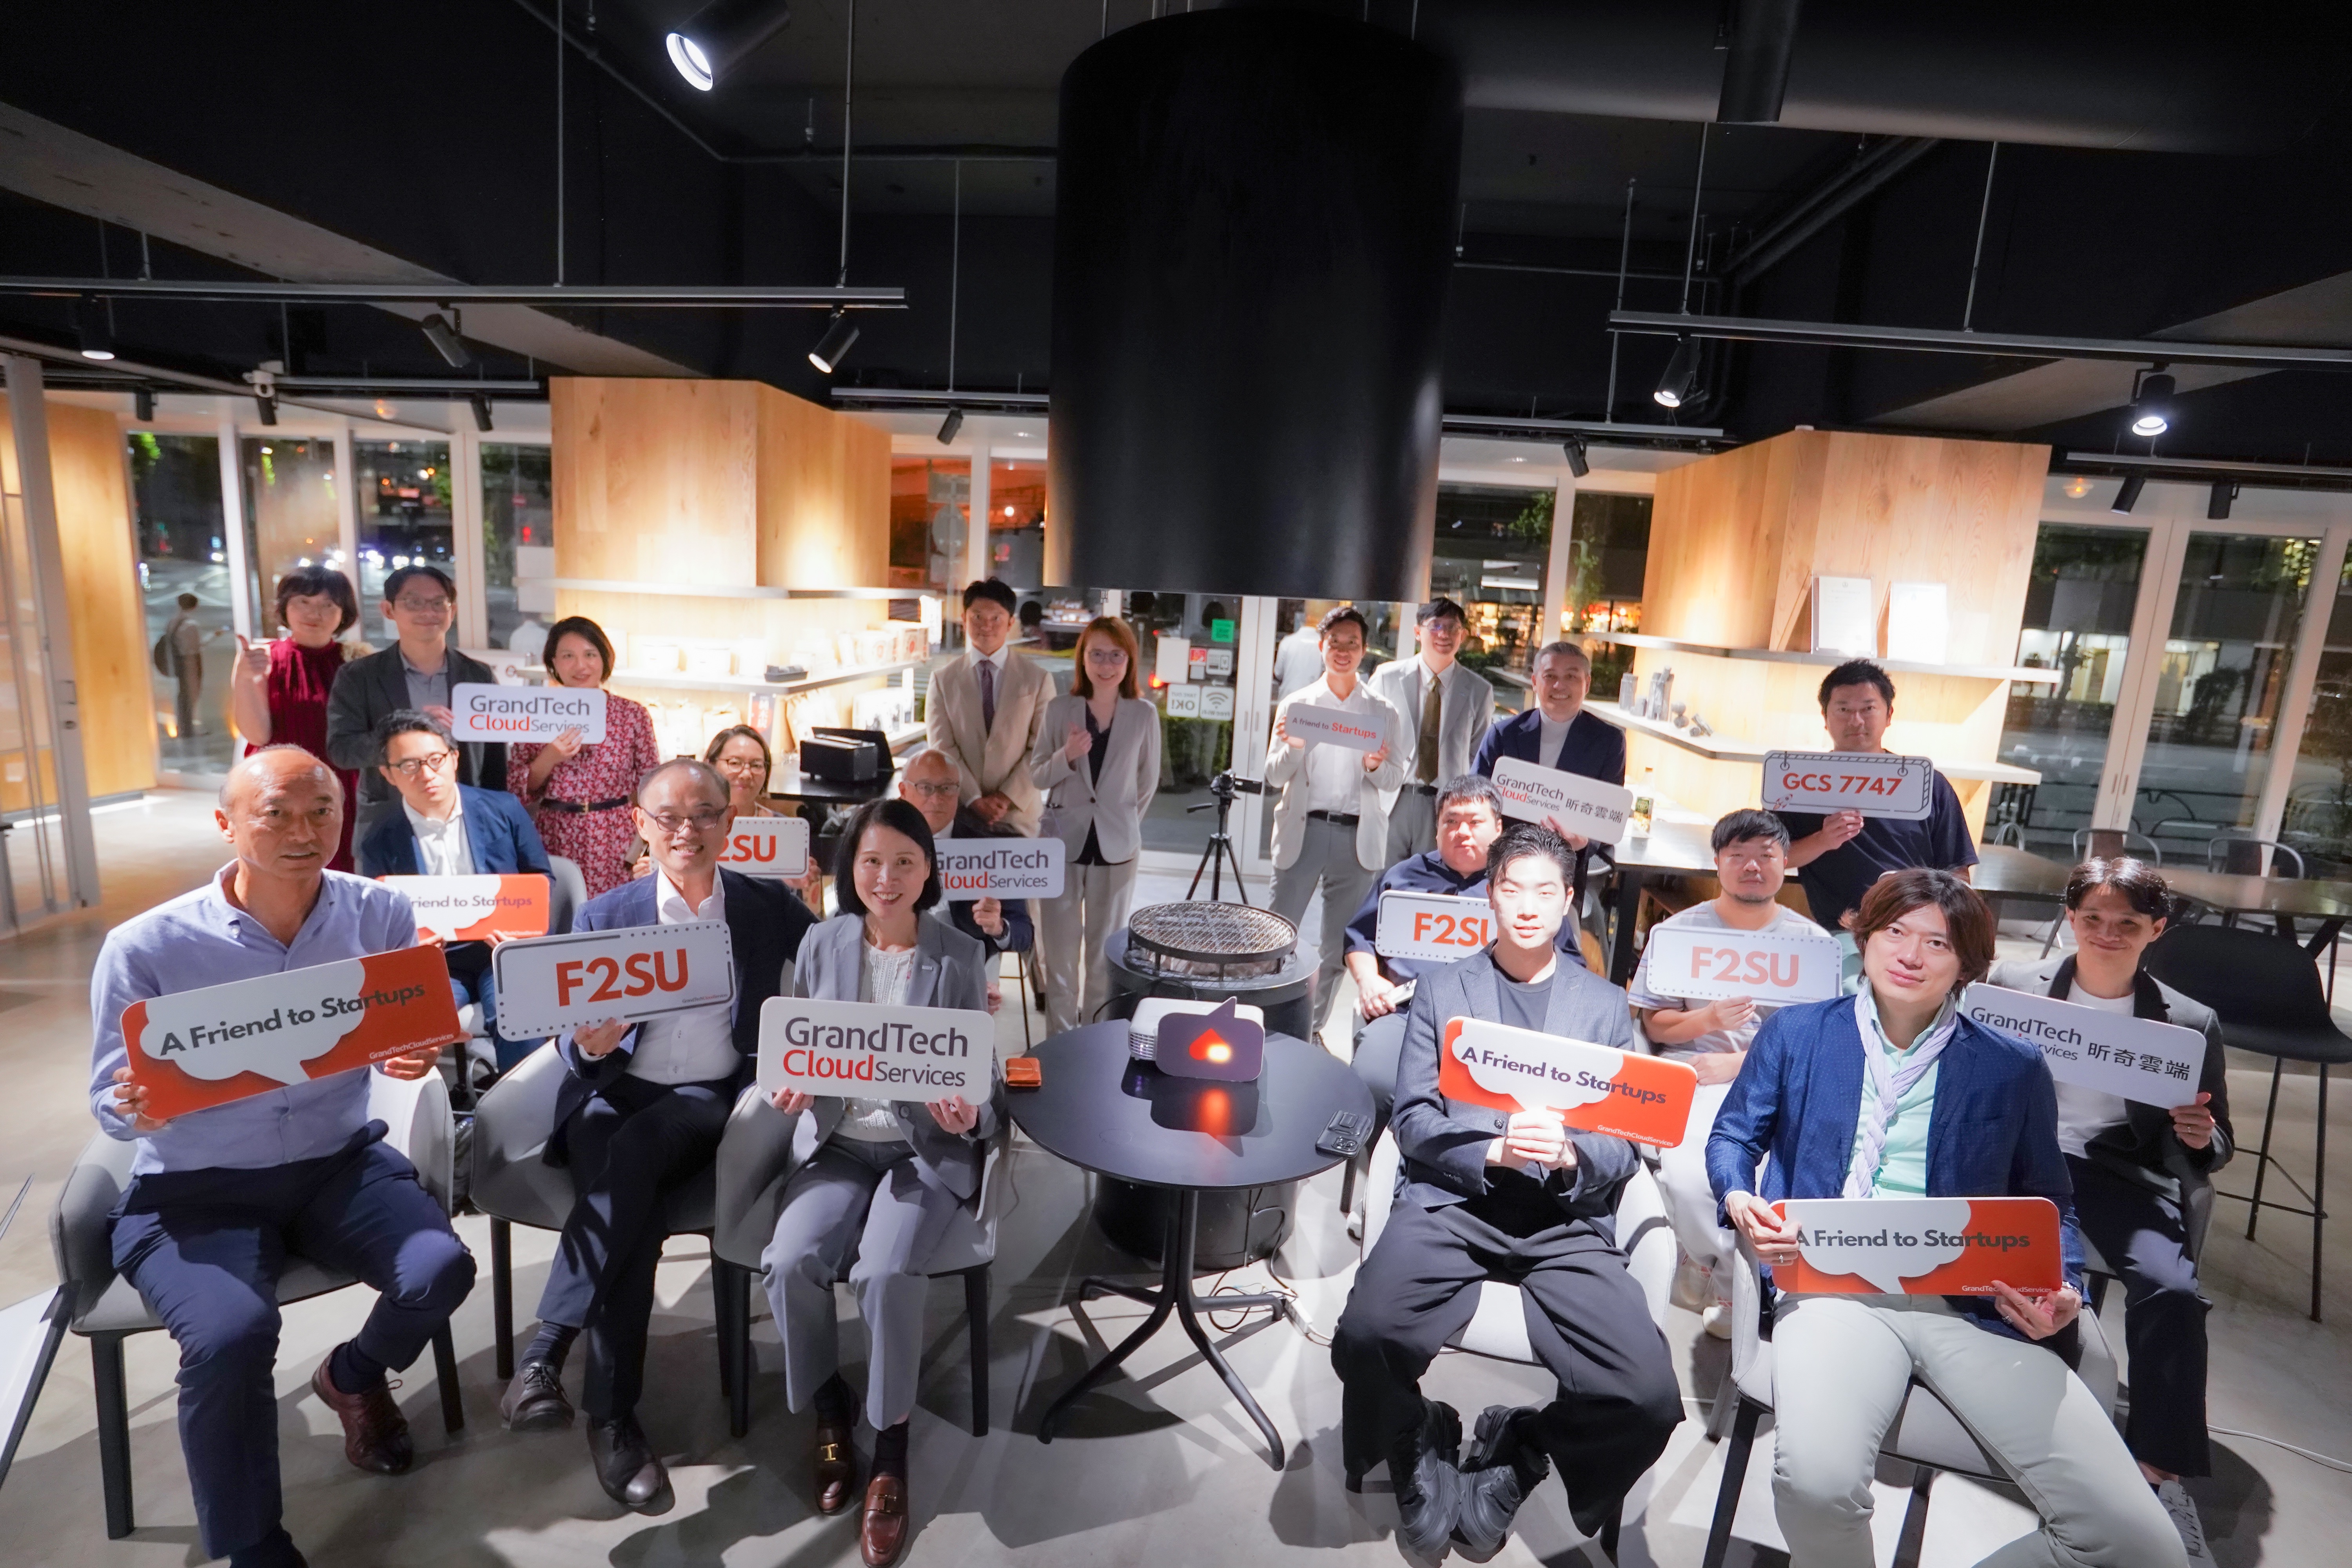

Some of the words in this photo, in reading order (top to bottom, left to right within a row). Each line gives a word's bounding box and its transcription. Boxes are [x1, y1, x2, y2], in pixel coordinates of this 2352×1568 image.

[470, 695, 590, 715] GrandTech
[1299, 718, 1320, 728] friend
[1332, 722, 1377, 739] Startups
[1497, 774, 1564, 801] GrandTech
[1782, 773, 1832, 792] GCS
[1839, 775, 1903, 796] 7747
[1566, 798, 1623, 824] 昕奇雲端
[716, 835, 776, 862] 2SU
[938, 871, 1048, 889] loudServices
[409, 896, 450, 908] riend
[454, 897, 468, 907] to
[472, 895, 532, 909] Startups
[556, 948, 688, 1007] F2SU
[1691, 946, 1799, 987] F2SU
[160, 1033, 186, 1056] A
[190, 1008, 281, 1049] Friend
[287, 1008, 316, 1026] to
[321, 983, 426, 1019] Startups
[1971, 1007, 2082, 1045] GrandTech
[369, 1034, 454, 1059] GrandTechCloudServices
[785, 1016, 968, 1057] GrandTech
[783, 1049, 965, 1087] CloudServices
[2088, 1042, 2190, 1081] 昕奇雲端
[1461, 1047, 1478, 1063] A
[1482, 1050, 1546, 1077] Friend
[1551, 1066, 1571, 1082] to
[1575, 1071, 1666, 1105] Startups
[1597, 1125, 1673, 1147] GrandTechCloudServices
[1797, 1230, 1810, 1246] A
[1815, 1229, 1888, 1247] Friend
[1893, 1232, 1918, 1247] to
[1924, 1230, 2030, 1252] Startups
